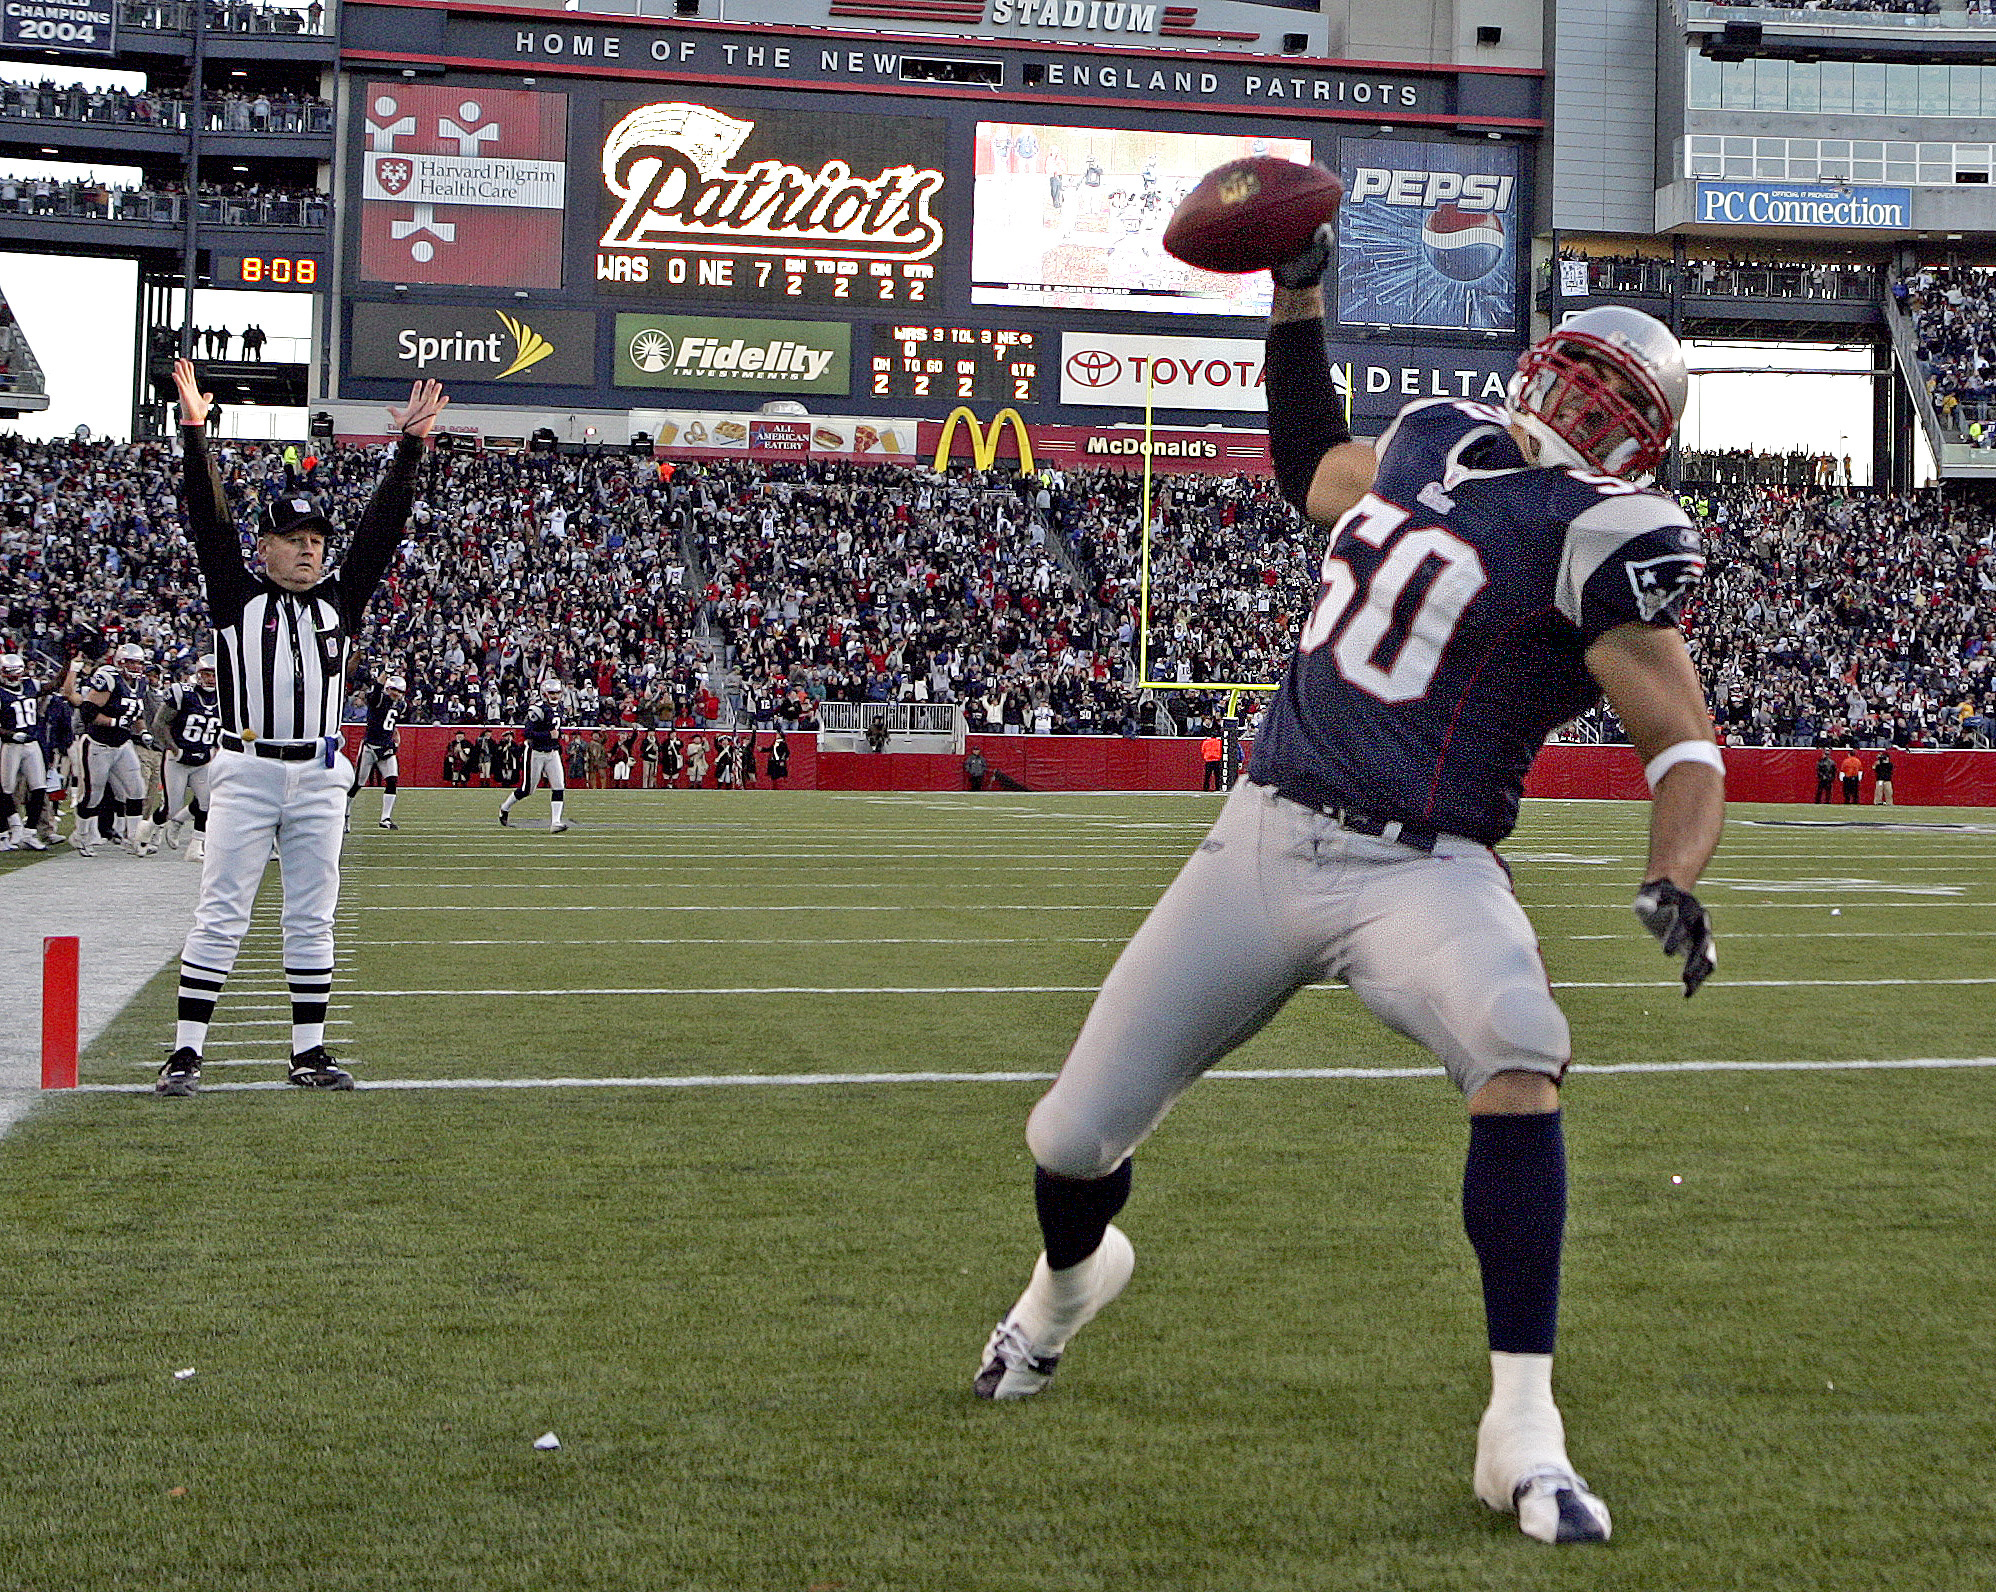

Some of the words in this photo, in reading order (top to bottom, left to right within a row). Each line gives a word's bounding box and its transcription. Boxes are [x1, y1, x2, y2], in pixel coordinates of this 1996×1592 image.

[6, 3, 110, 24] CHAMPIONS
[992, 0, 1157, 32] STADIUM
[18, 20, 95, 43] 2004
[515, 32, 620, 58] HOME
[651, 39, 696, 62] OF
[722, 44, 791, 69] THE
[821, 50, 898, 74] NEW
[1048, 64, 1219, 94] ENGLAND
[1246, 76, 1417, 106] PATRIOTS
[420, 160, 491, 180] Harvard
[494, 164, 556, 185] Pilgrim
[420, 178, 476, 198] Health
[478, 182, 517, 199] Care
[600, 138, 945, 260] Patriots
[1350, 167, 1514, 212] PEPSI
[1703, 189, 1745, 222] PC
[1748, 191, 1903, 226] Connection
[241, 257, 317, 284] 8:08
[595, 253, 650, 283] WAS
[667, 256, 687, 285] 0
[697, 258, 736, 287] NE
[754, 261, 773, 288] 7
[785, 274, 803, 296] 2
[833, 276, 849, 298] 2
[878, 278, 896, 300] 2
[908, 279, 925, 301] 2
[398, 329, 501, 369] Sprint
[893, 326, 928, 342] WAS
[932, 327, 945, 342] 3
[950, 328, 975, 344] TOL
[980, 329, 992, 344] 3
[996, 330, 1020, 345] NE
[675, 337, 834, 381] Fidelity
[992, 344, 1007, 362] 7
[672, 368, 800, 381] INVESTMENTS
[903, 358, 921, 372] TO
[925, 359, 943, 374] GO
[1009, 362, 1037, 378] QTR
[873, 373, 889, 394] 2
[914, 374, 930, 396] 2
[957, 377, 973, 397] 2
[1014, 379, 1030, 400] 2
[1366, 365, 1507, 399] DELTA
[757, 432, 810, 442] AMERICAN
[773, 424, 795, 433] ALL
[764, 440, 804, 450] EATERY
[1086, 436, 1219, 458] McDonald's
[1300, 491, 1488, 706] 50
